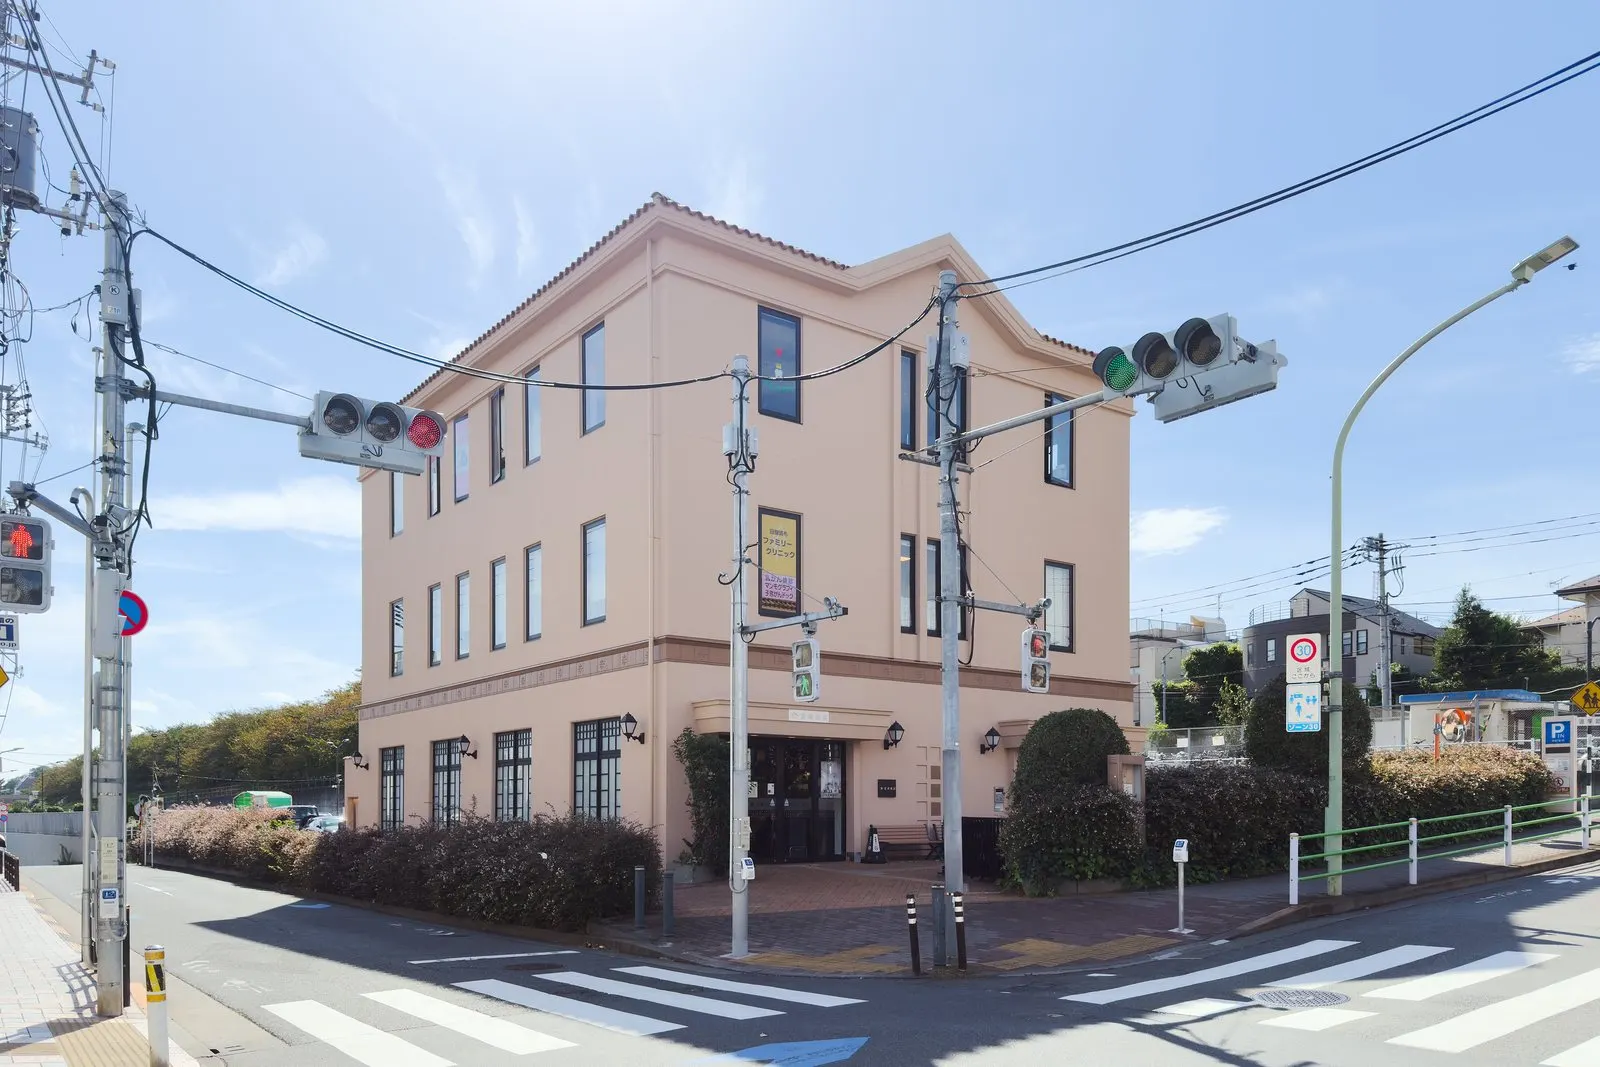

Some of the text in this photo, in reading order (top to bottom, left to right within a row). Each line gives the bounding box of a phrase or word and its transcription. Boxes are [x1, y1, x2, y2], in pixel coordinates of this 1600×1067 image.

[763, 537, 792, 547] ファミリー
[766, 548, 795, 558] クリニック
[1296, 645, 1311, 656] 30
[1552, 723, 1565, 738] P
